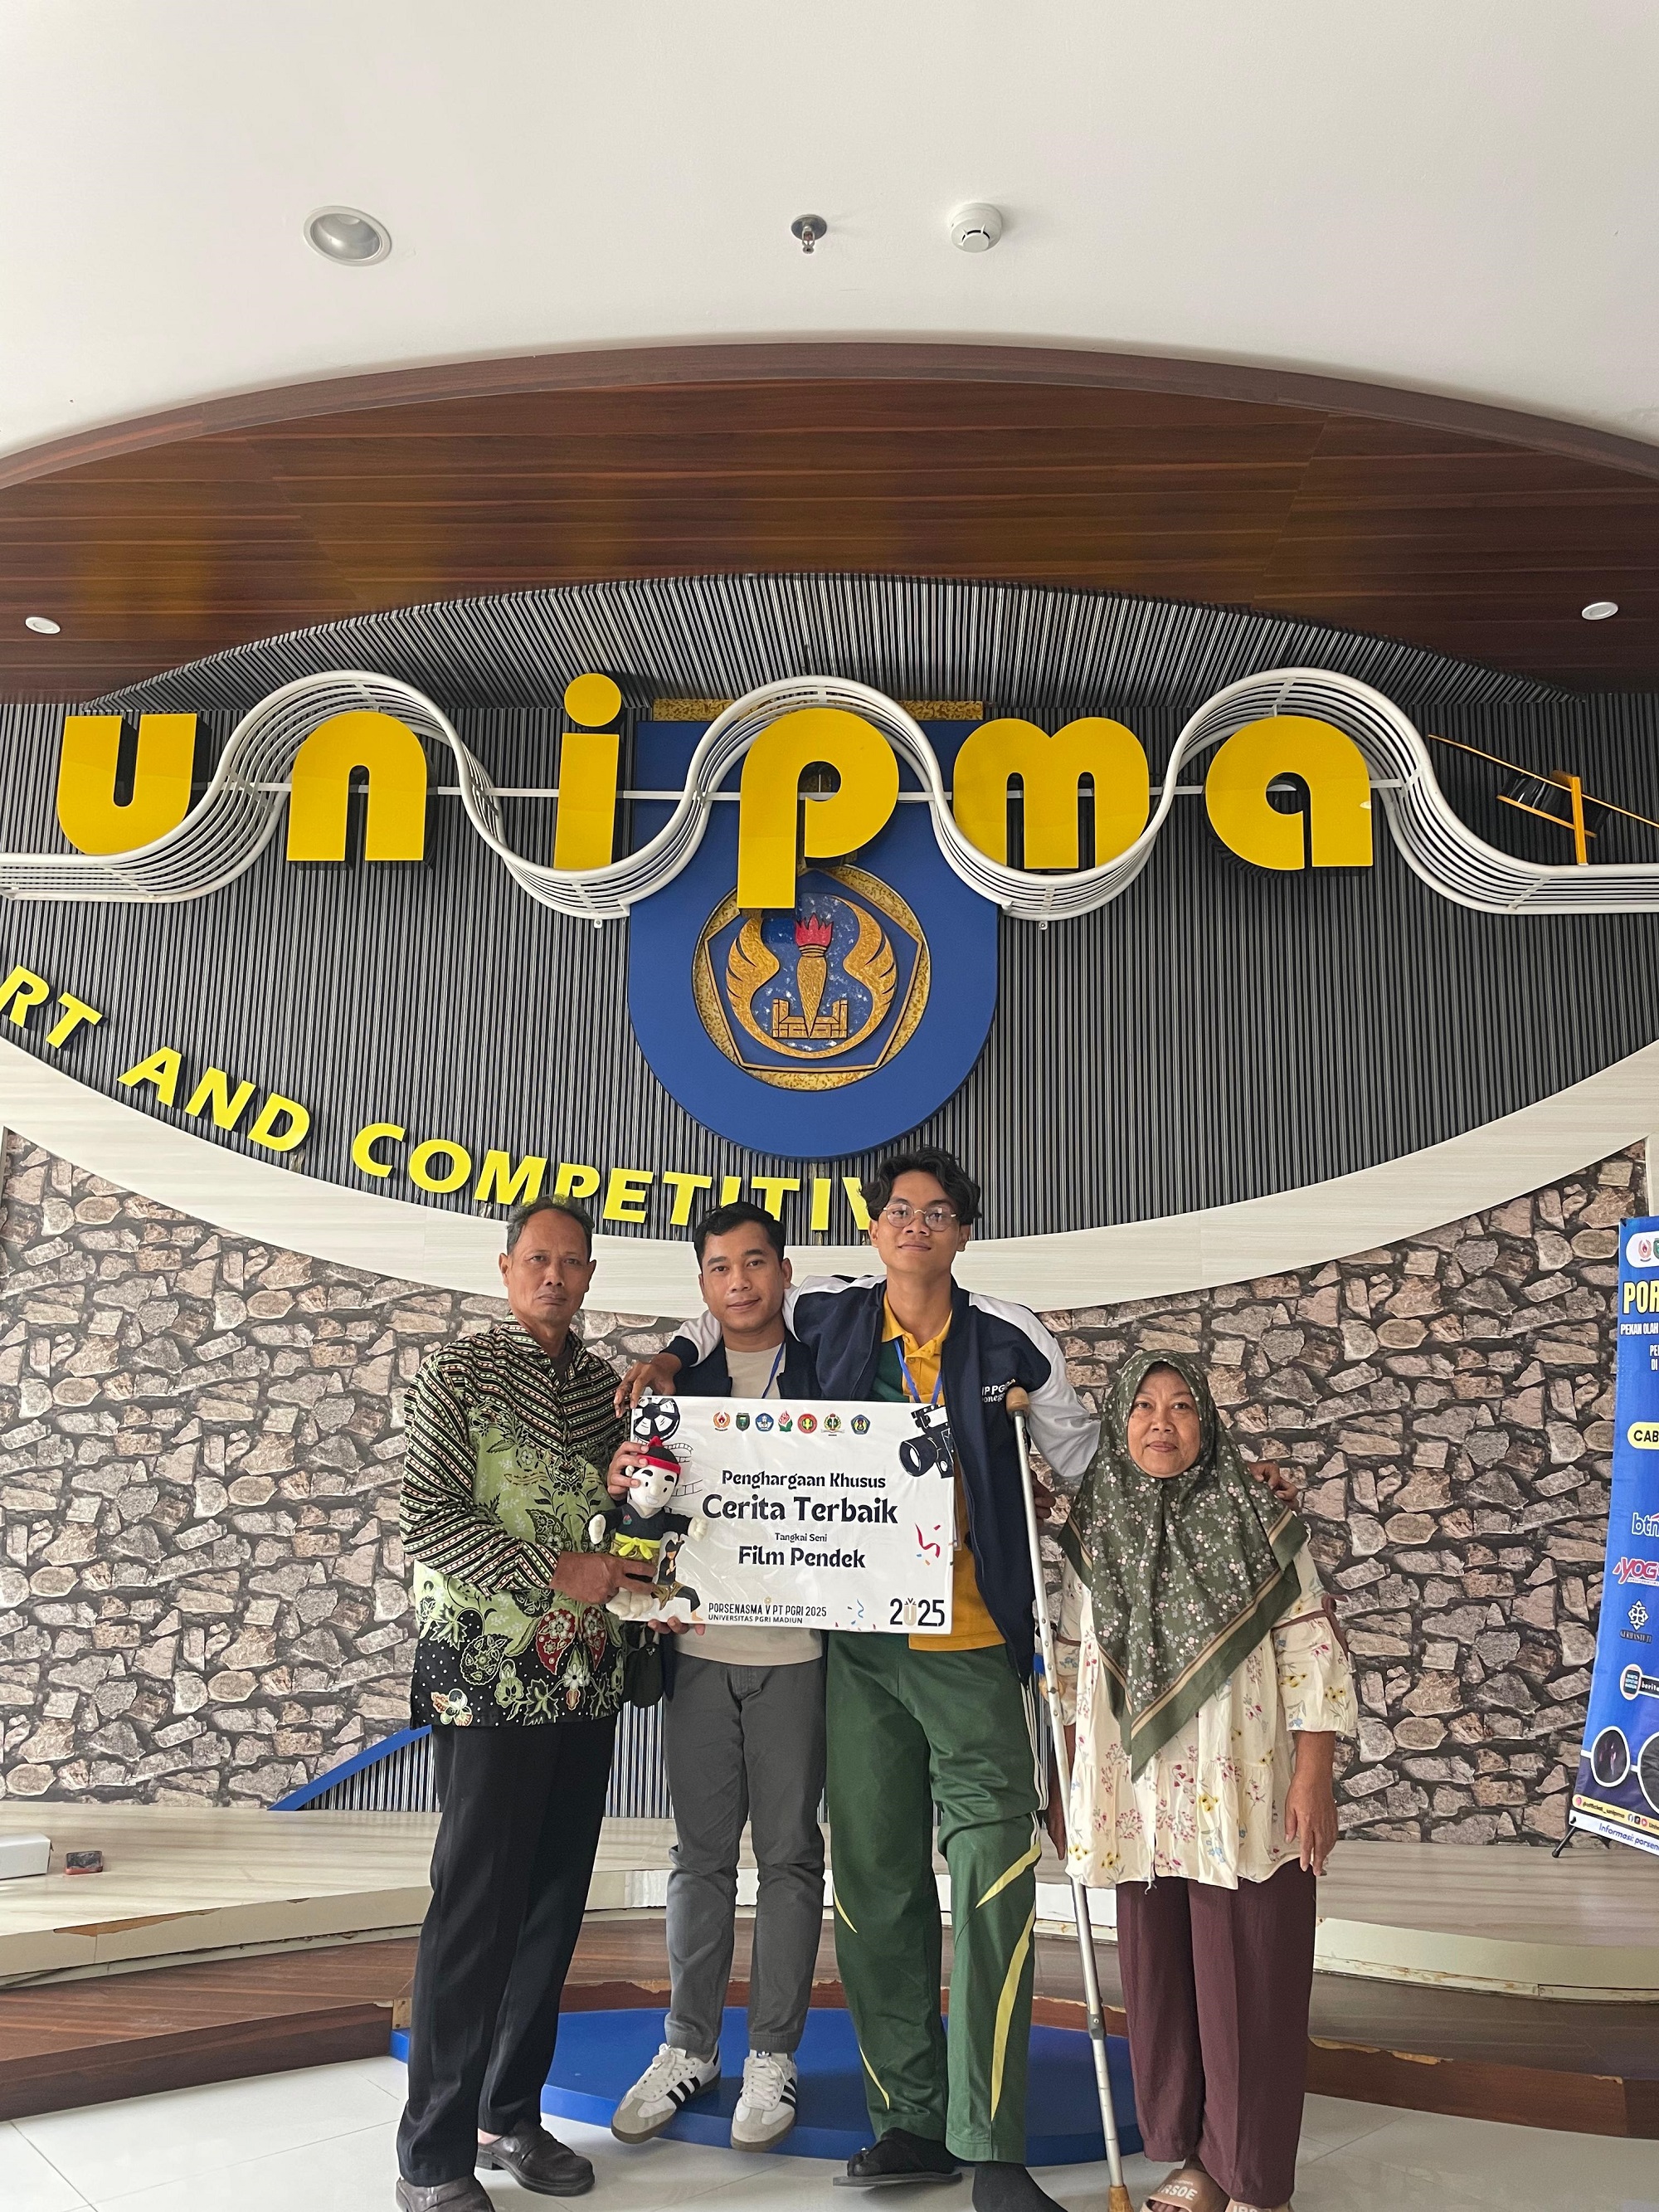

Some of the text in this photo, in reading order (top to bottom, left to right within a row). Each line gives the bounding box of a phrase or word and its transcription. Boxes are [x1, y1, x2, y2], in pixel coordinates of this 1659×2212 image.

[56, 672, 1374, 909] unipma
[117, 1046, 311, 1152] AND
[1620, 1323, 1642, 1335] PEKAN
[722, 1469, 886, 1489] Penghargaan Khusus
[702, 1493, 898, 1524] Cerita Terbaik
[775, 1532, 827, 1542] Tangkai Seni
[738, 1545, 866, 1568] Film Pendek
[708, 1602, 827, 1616] PORSENASMA V PT PGRI 2025
[708, 1614, 753, 1622] UNIVERSITAS
[1599, 1823, 1634, 1842] Informasi:
